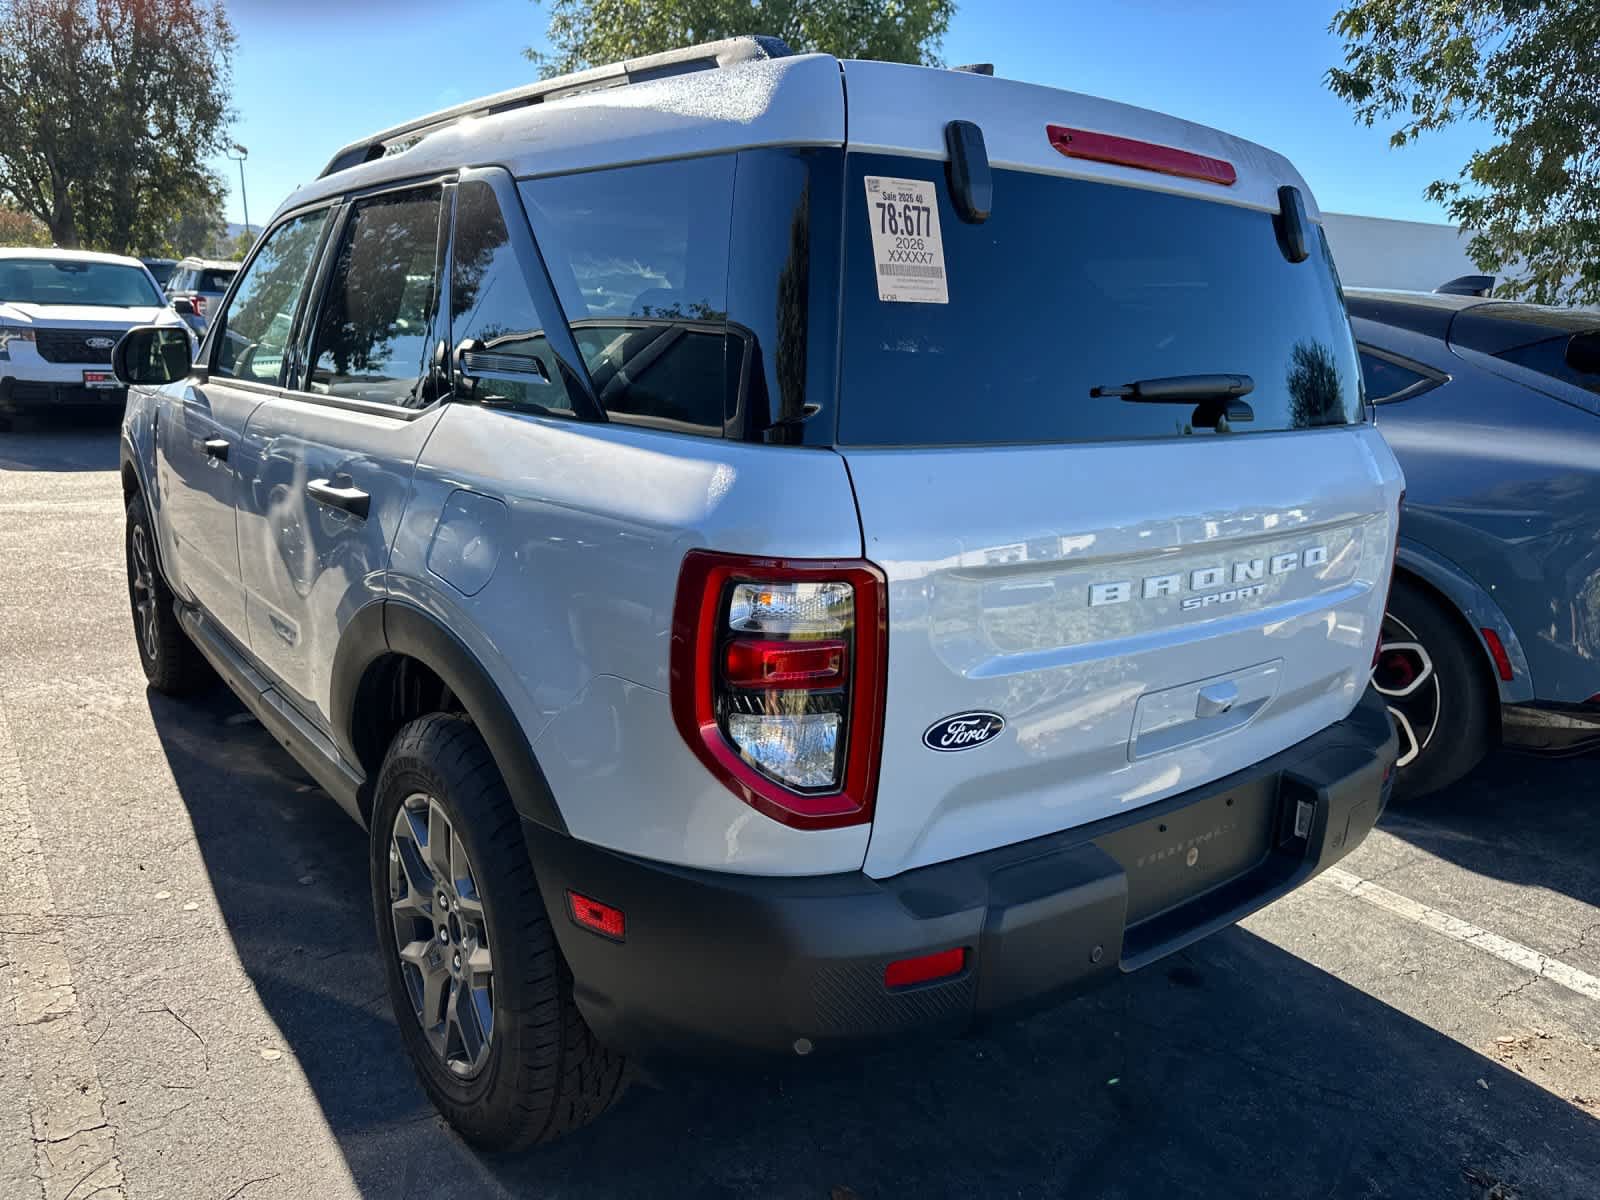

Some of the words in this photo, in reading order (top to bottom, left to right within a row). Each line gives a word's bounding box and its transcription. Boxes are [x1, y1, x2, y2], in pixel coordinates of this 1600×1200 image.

[895, 237, 925, 251] 2026
[1088, 546, 1328, 607] BRONCO
[1180, 583, 1265, 612] SPORT
[941, 718, 992, 746] Ford
